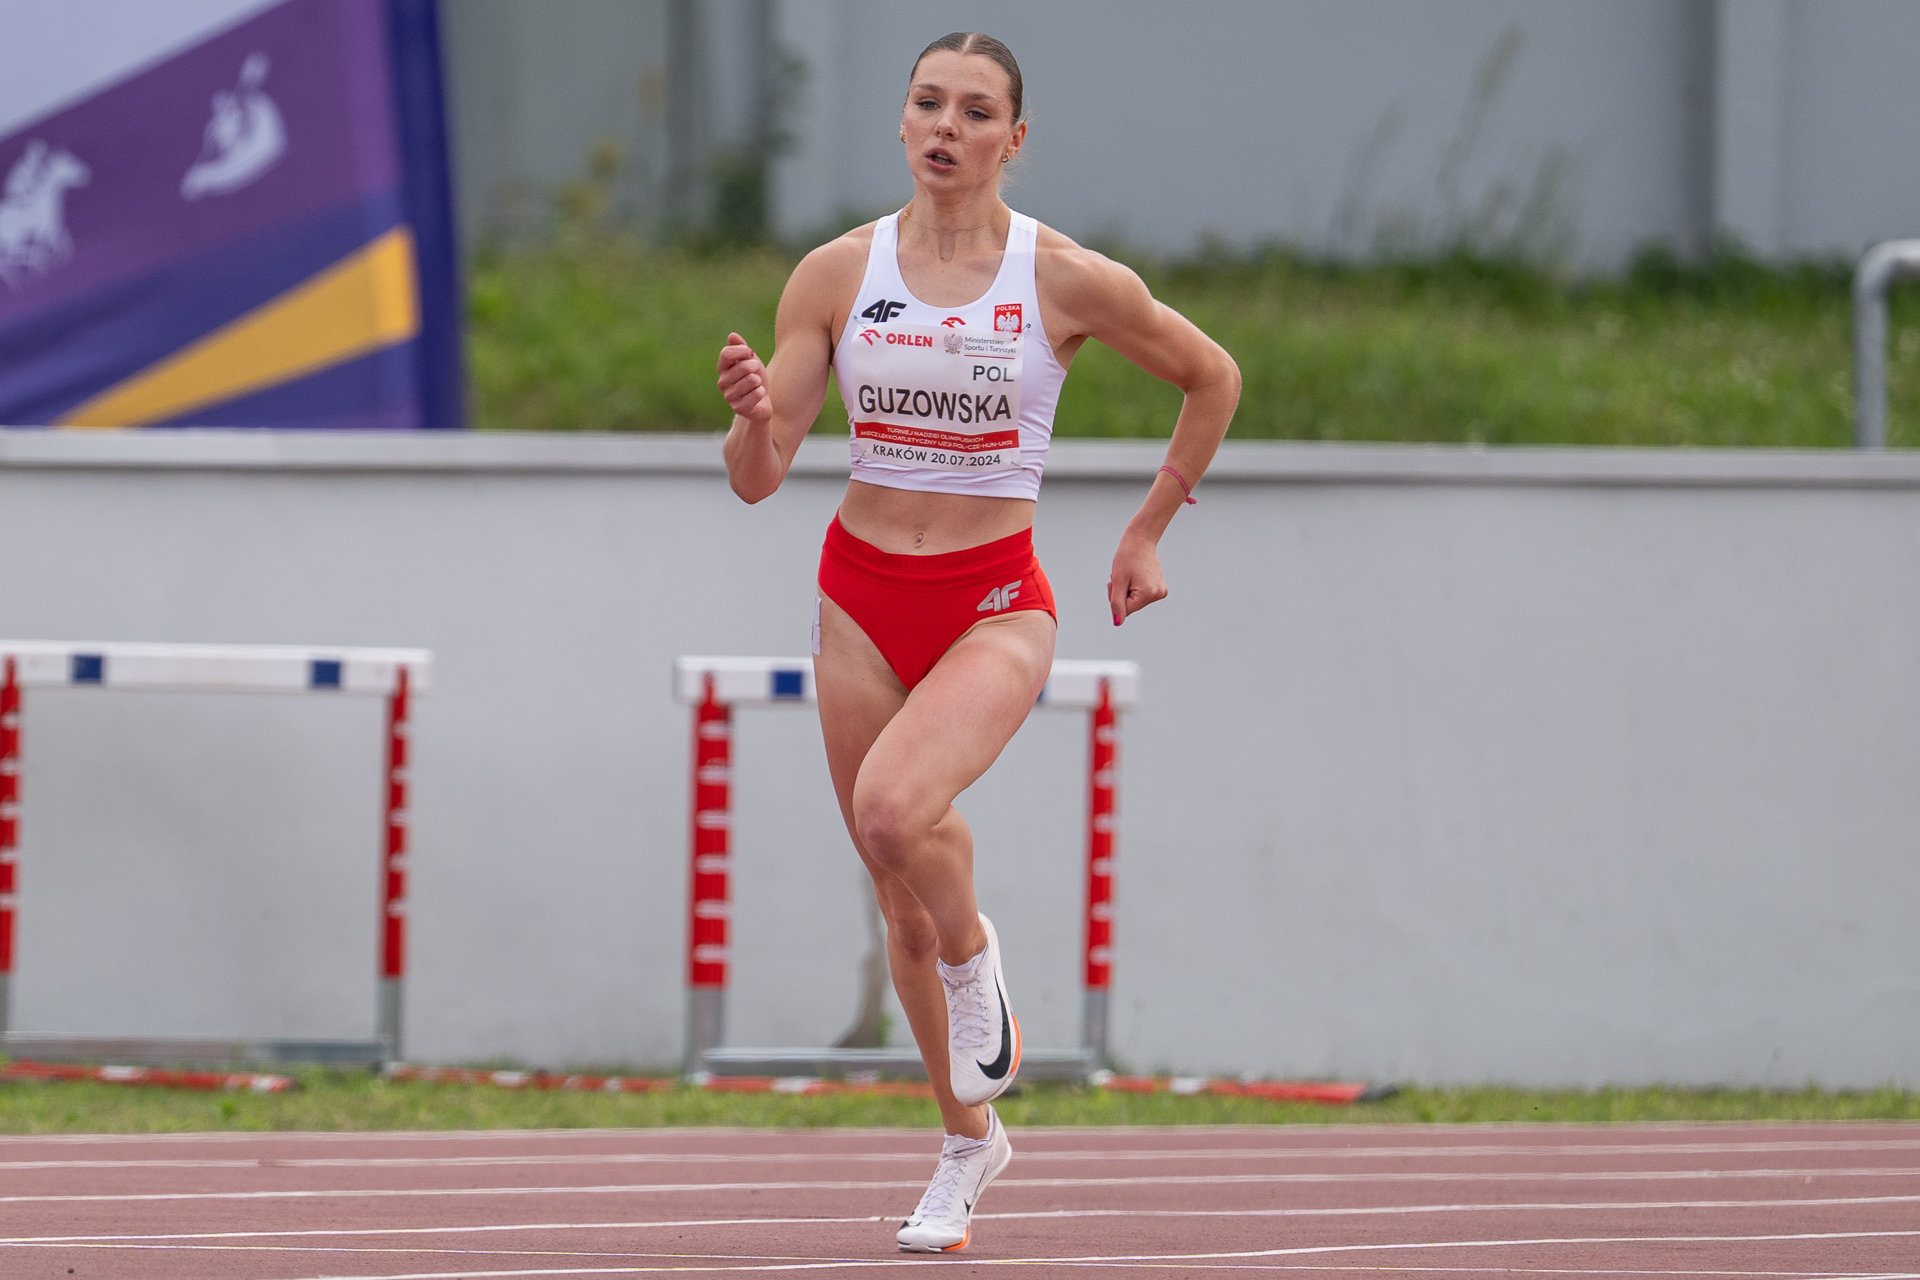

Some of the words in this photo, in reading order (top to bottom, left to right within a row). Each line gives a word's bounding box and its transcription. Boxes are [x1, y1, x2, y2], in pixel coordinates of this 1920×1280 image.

[861, 299, 907, 323] 4F
[886, 332, 933, 348] ORLEN
[964, 337, 1004, 345] Ministerstwo
[964, 344, 985, 352] Sportu
[989, 346, 1017, 354] Turystyki
[972, 365, 1014, 382] POL
[858, 384, 1012, 424] GUZOWSKA
[860, 430, 878, 438] MECZ
[878, 433, 937, 445] LEKKOATLETYCZNY
[938, 440, 952, 448] U23
[886, 427, 913, 436] TURNIEJ
[914, 431, 939, 439] NADZIEI
[872, 444, 927, 461] KRAKÓW
[931, 452, 1001, 467] 20.07.2024
[976, 580, 1023, 613] 4F
